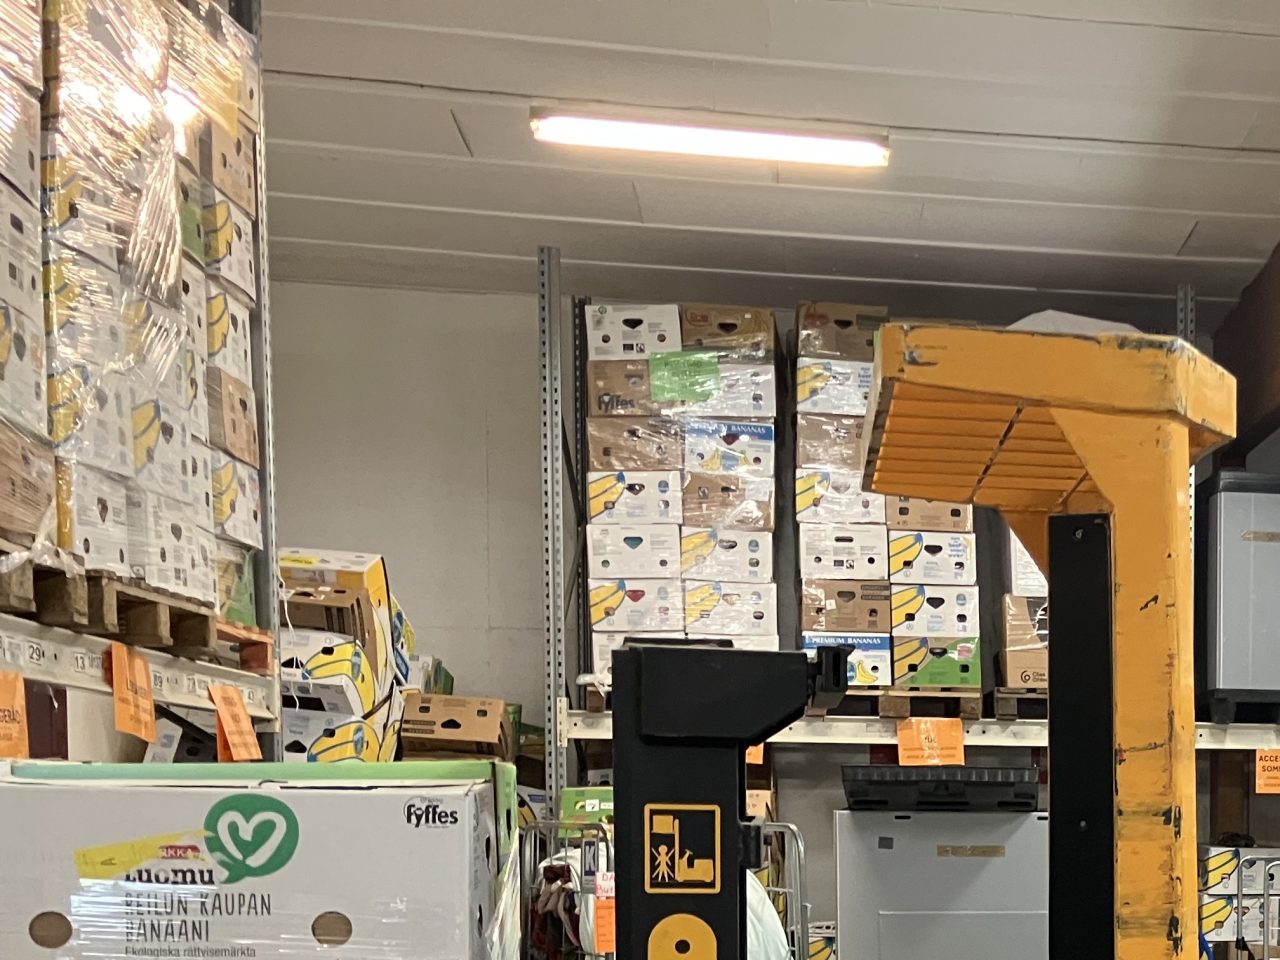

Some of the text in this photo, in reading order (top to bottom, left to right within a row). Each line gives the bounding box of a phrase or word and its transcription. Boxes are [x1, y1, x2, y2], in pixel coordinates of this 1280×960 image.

[812, 637, 881, 645] PREMIUM BANANAS
[200, 892, 272, 916] KAUPAN
[125, 918, 210, 942] BANAANI
